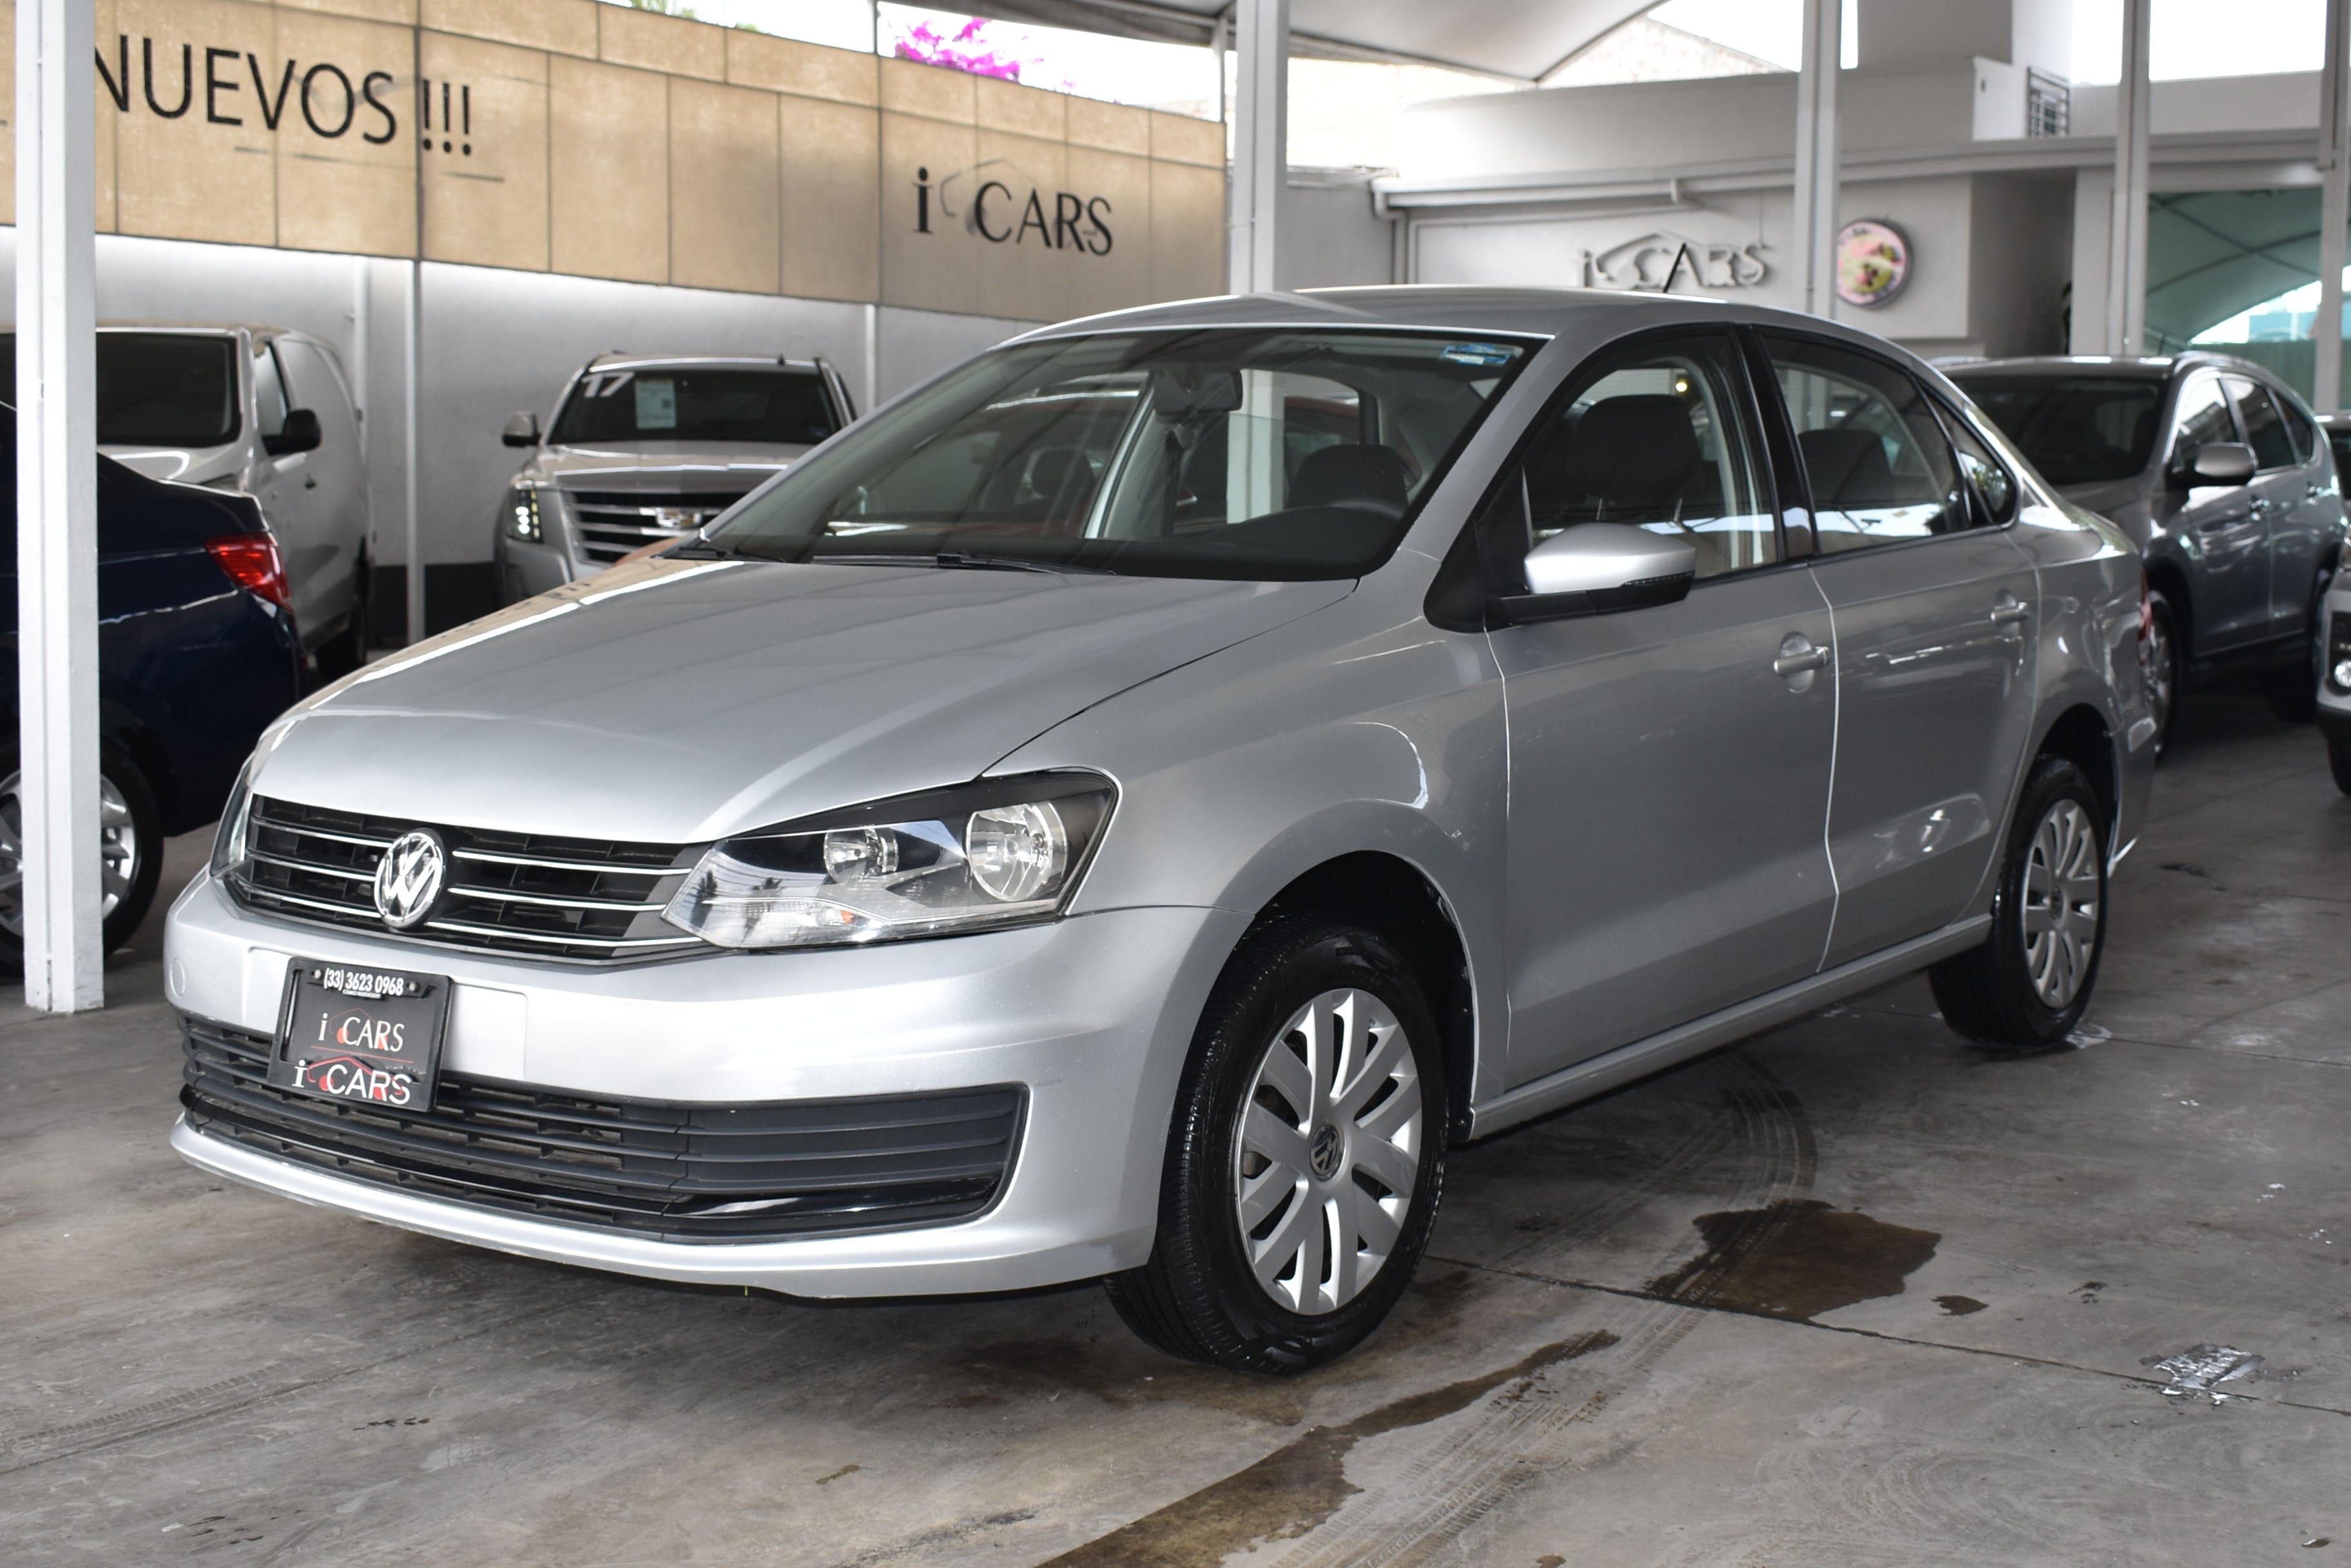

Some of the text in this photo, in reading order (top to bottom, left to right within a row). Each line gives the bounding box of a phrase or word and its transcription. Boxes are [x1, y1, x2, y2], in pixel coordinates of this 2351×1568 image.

[974, 180, 1113, 256] CARS
[581, 371, 635, 398] 17
[324, 967, 344, 991] (33)
[345, 971, 374, 992] 3623
[374, 975, 404, 996] 0968
[317, 1012, 405, 1052] i CARS
[291, 1059, 413, 1105] i CARS
